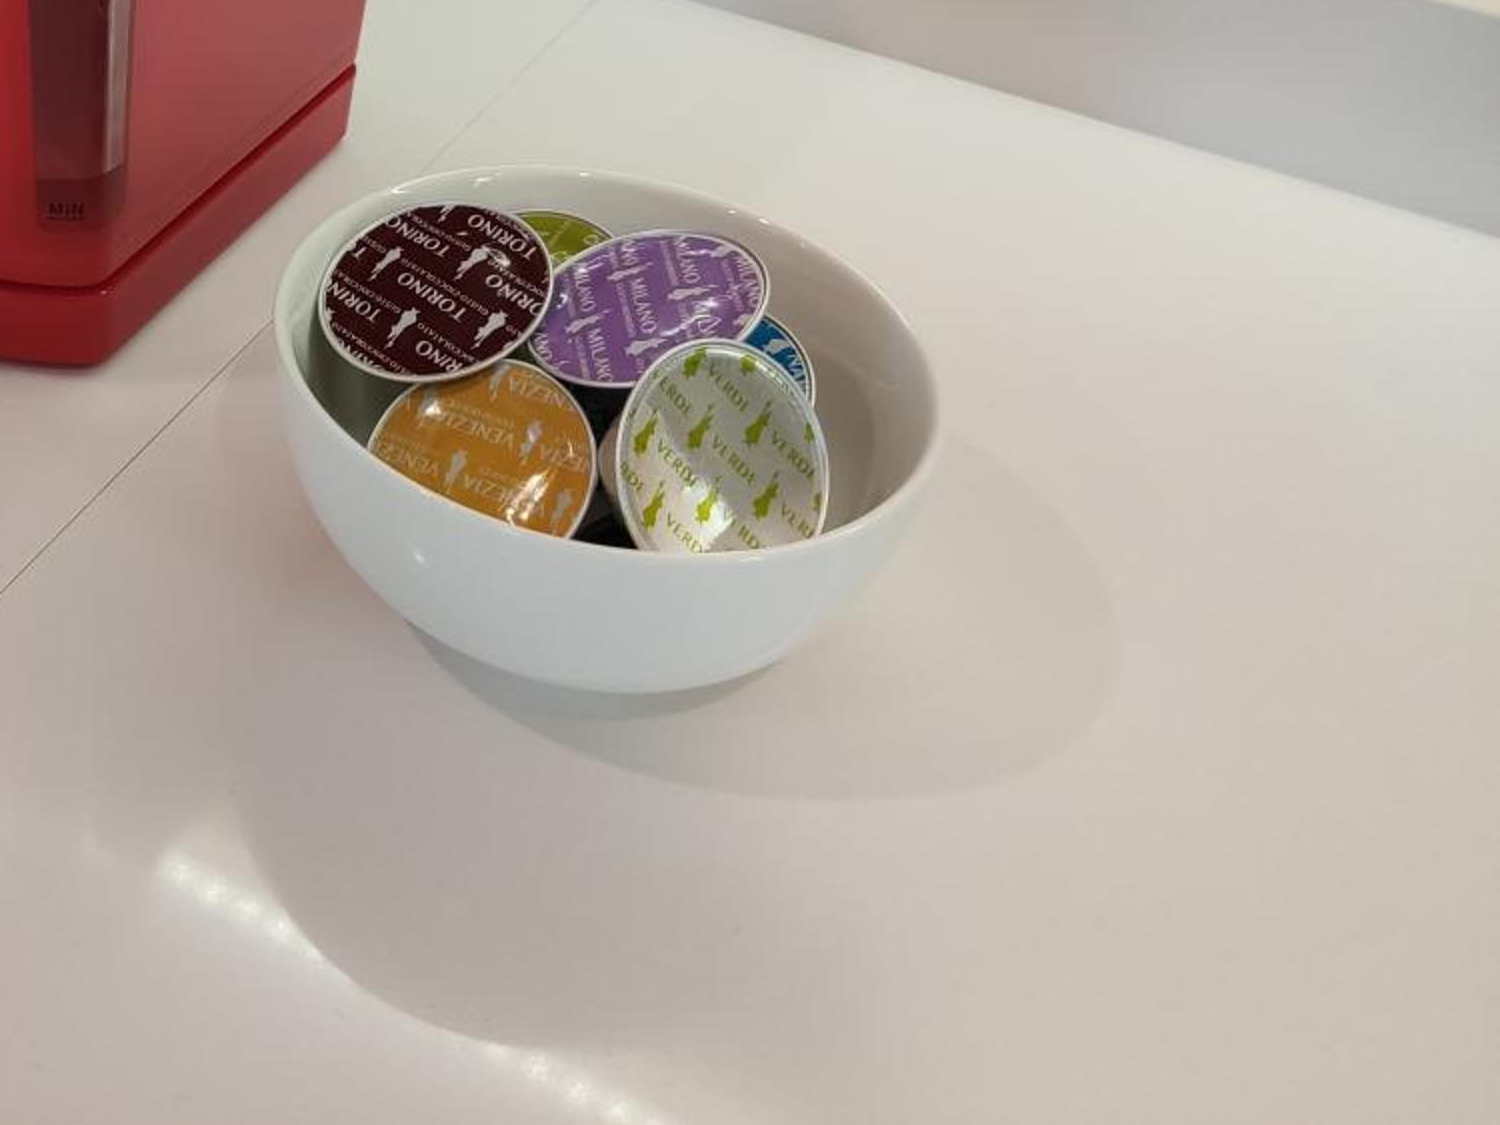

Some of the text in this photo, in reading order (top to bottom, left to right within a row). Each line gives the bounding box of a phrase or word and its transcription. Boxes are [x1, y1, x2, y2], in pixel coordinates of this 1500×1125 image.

[47, 202, 85, 217] MIN
[467, 213, 538, 260] TORINO
[397, 272, 467, 323] TORINO
[630, 276, 658, 335] MILANO
